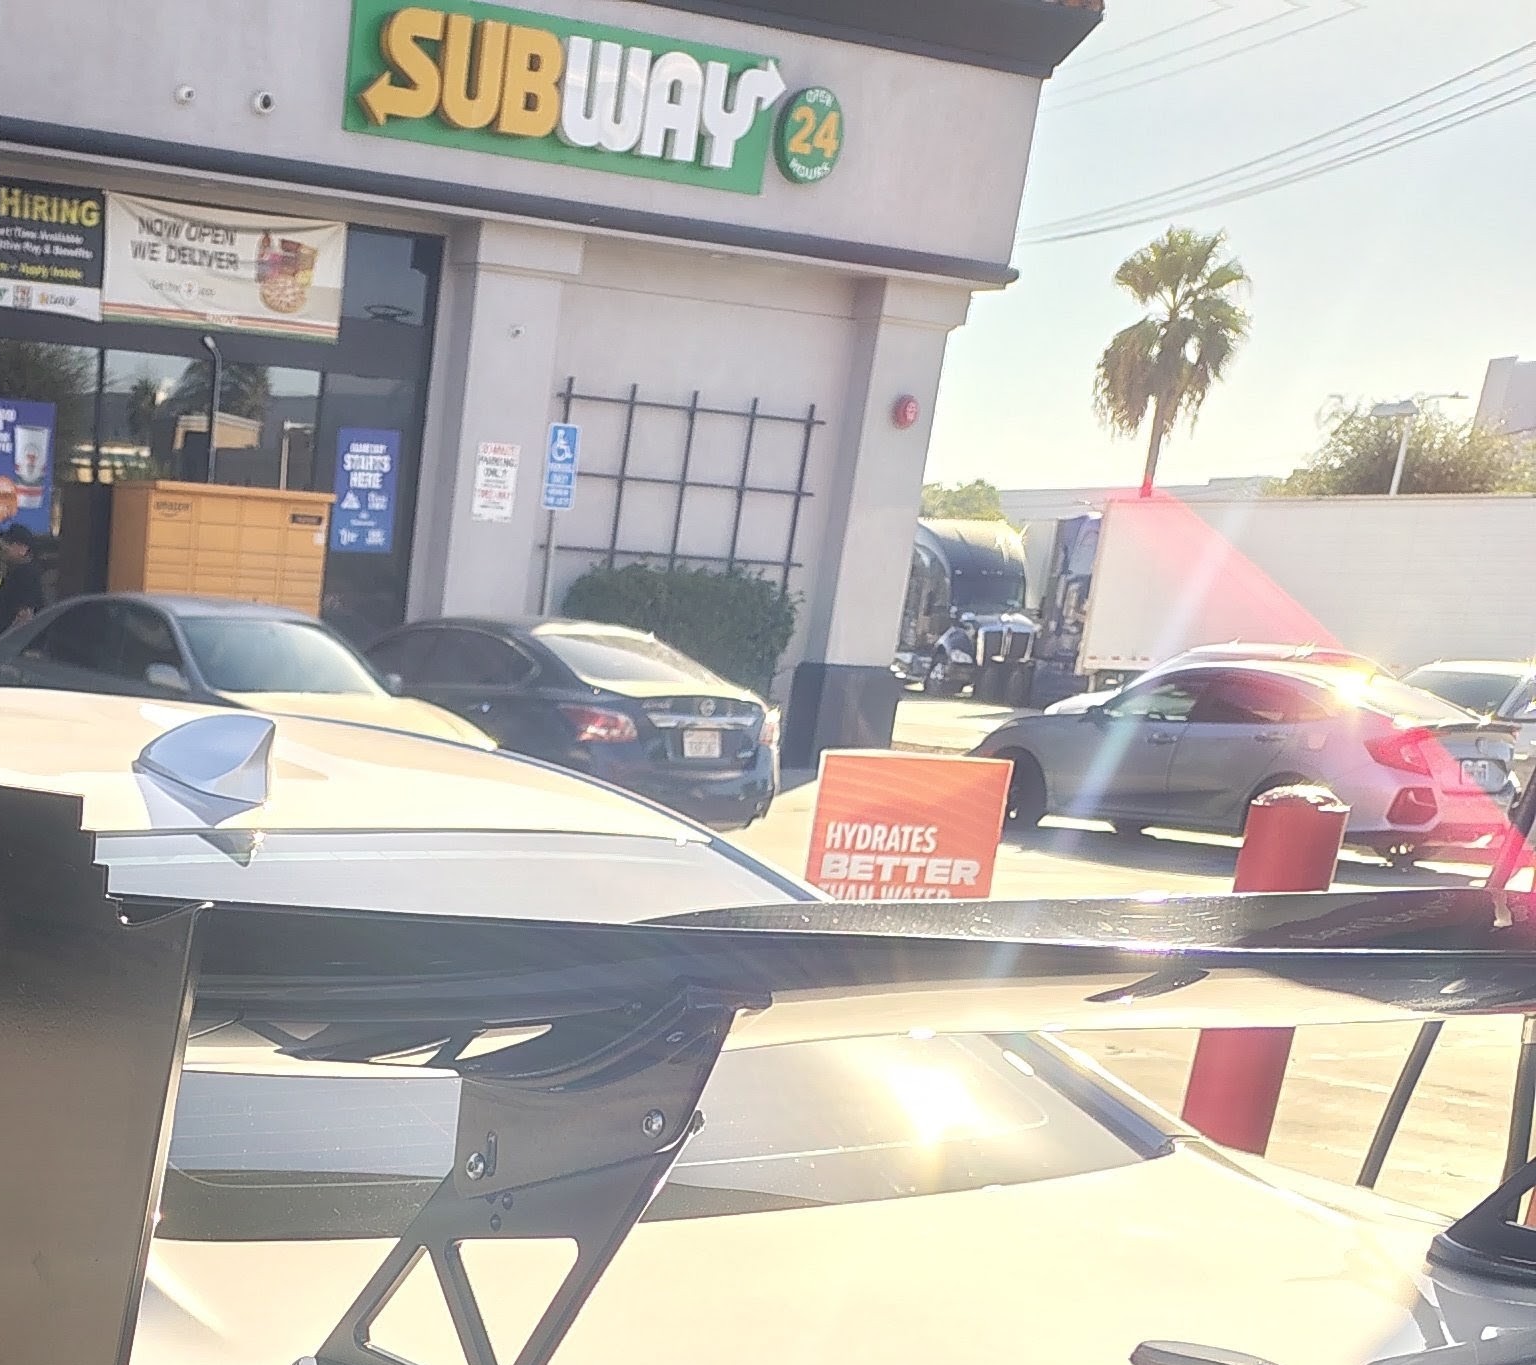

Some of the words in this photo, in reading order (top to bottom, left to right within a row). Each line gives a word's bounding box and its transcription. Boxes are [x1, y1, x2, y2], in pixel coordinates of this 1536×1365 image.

[362, 7, 786, 168] SUBWAY
[805, 88, 834, 108] OPEN
[788, 105, 840, 158] 24
[788, 157, 832, 180] HOURS
[137, 216, 184, 239] NOW
[185, 221, 239, 246] OPEN
[130, 239, 161, 262] WE
[165, 243, 240, 271] DELIVER
[825, 822, 938, 853] HYDRATES
[820, 853, 981, 885] BETTER
